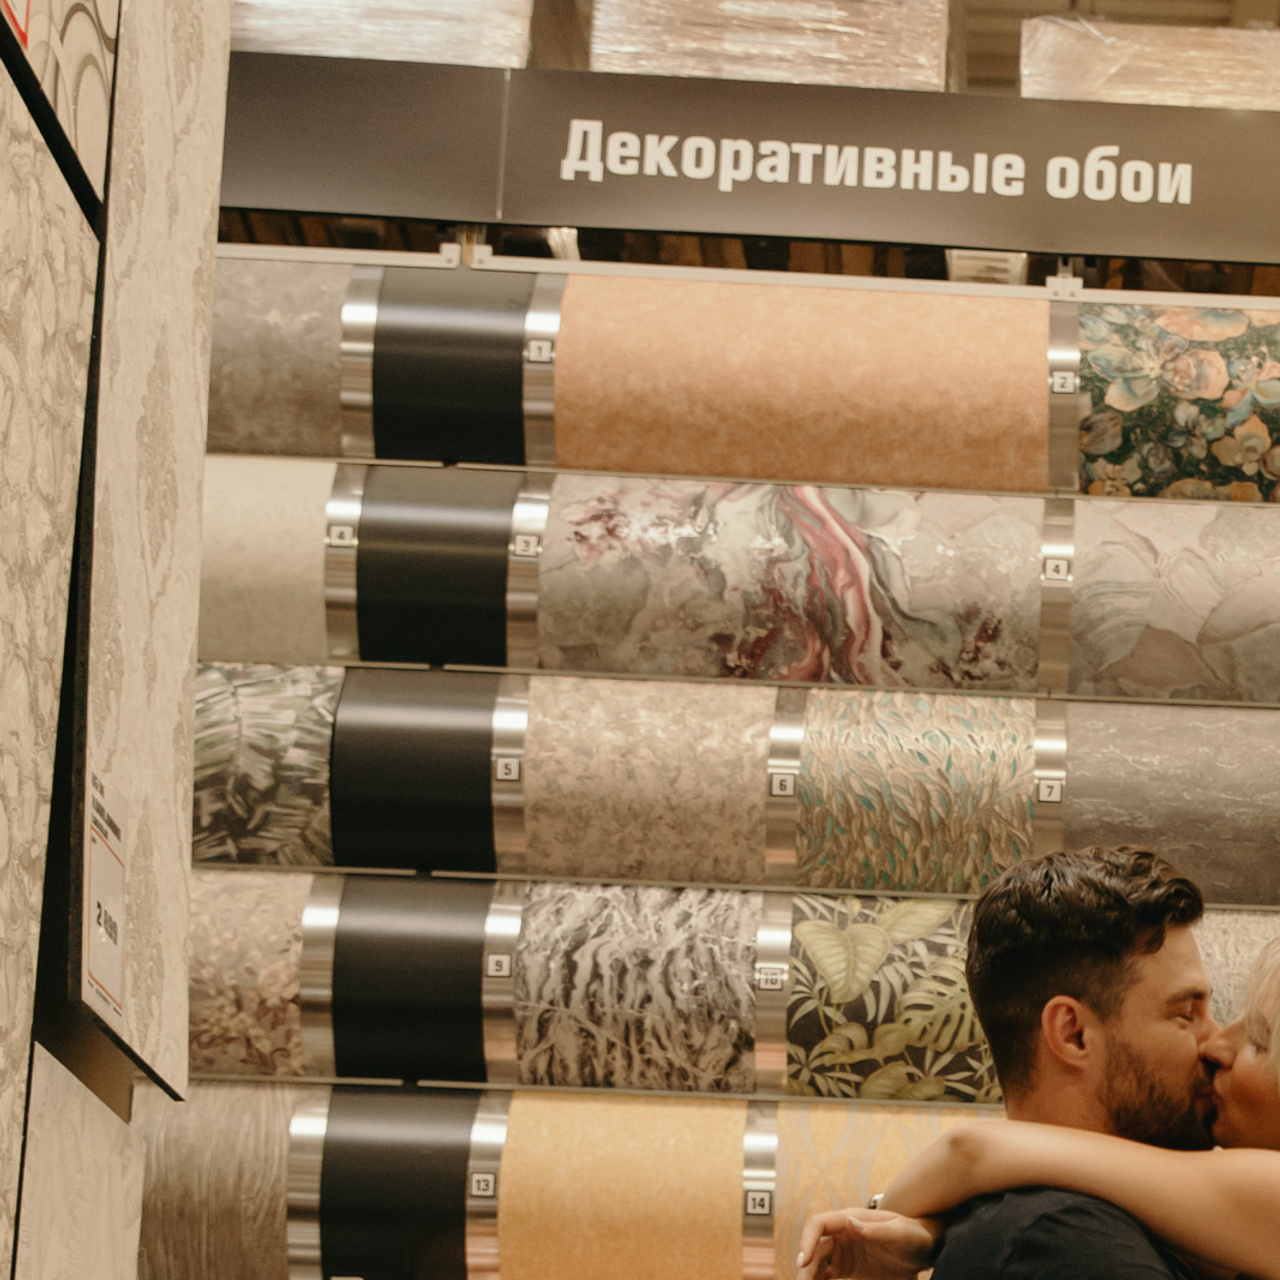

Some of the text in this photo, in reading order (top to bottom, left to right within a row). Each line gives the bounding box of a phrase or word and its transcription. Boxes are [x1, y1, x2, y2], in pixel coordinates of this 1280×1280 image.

[560, 118, 1193, 205] Декоративные обои
[1058, 376, 1067, 389] 2
[503, 763, 512, 776] 5
[779, 779, 787, 792] 6
[1046, 785, 1054, 797] 7
[495, 960, 503, 972] 9
[475, 1179, 489, 1192] 13
[751, 1197, 766, 1209] 14
